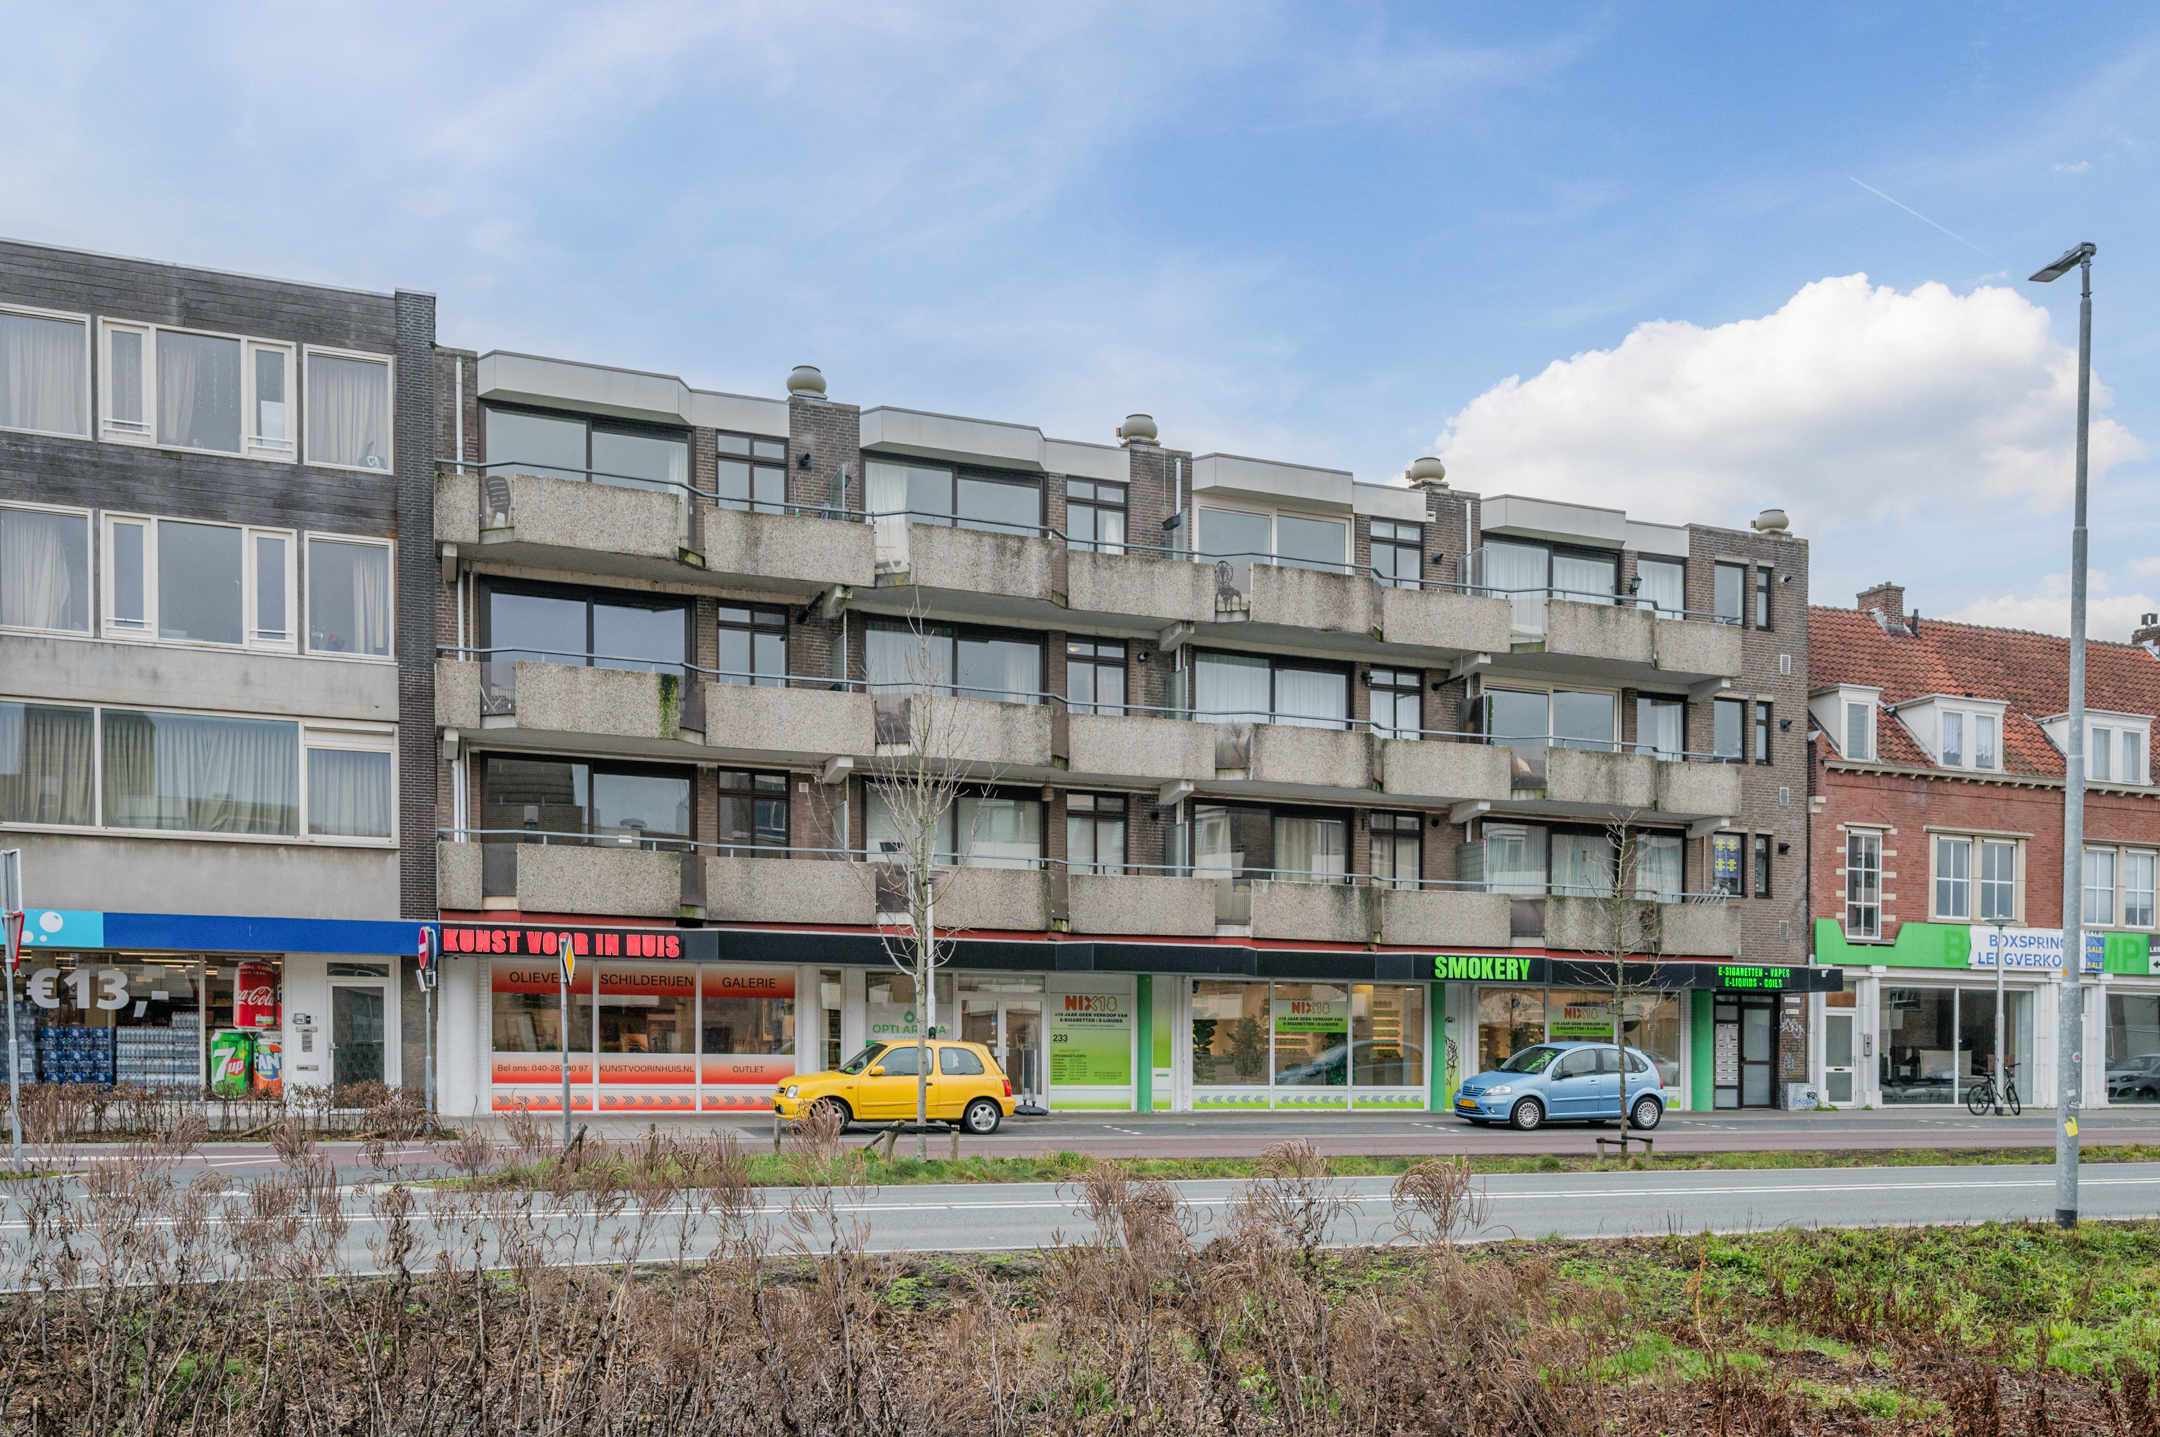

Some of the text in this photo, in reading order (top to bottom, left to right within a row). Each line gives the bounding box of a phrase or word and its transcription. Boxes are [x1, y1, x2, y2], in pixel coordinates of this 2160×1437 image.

[443, 928, 520, 953] KUNST
[596, 934, 619, 956] IN
[626, 934, 680, 958] HUIS
[1434, 956, 1531, 980] SMOKERY
[1718, 966, 1763, 977] E-SIGARETTEN
[1770, 968, 1790, 978] VAPES
[509, 971, 576, 985] OLIEVE
[600, 974, 694, 987] SCHILDERIJEN
[722, 977, 776, 989] GALERIE
[1725, 977, 1757, 988] E-LIQUIDS
[1764, 978, 1783, 988] COILS
[26, 968, 169, 1018] €13,-
[1065, 995, 1117, 1011] NIX18
[1292, 1002, 1330, 1014] NIX18
[1564, 1008, 1598, 1019] NIX18
[872, 1024, 899, 1033] OPTI
[1052, 1034, 1068, 1042] 233
[600, 1065, 694, 1073] KUNSTVOORINHUIS.NL
